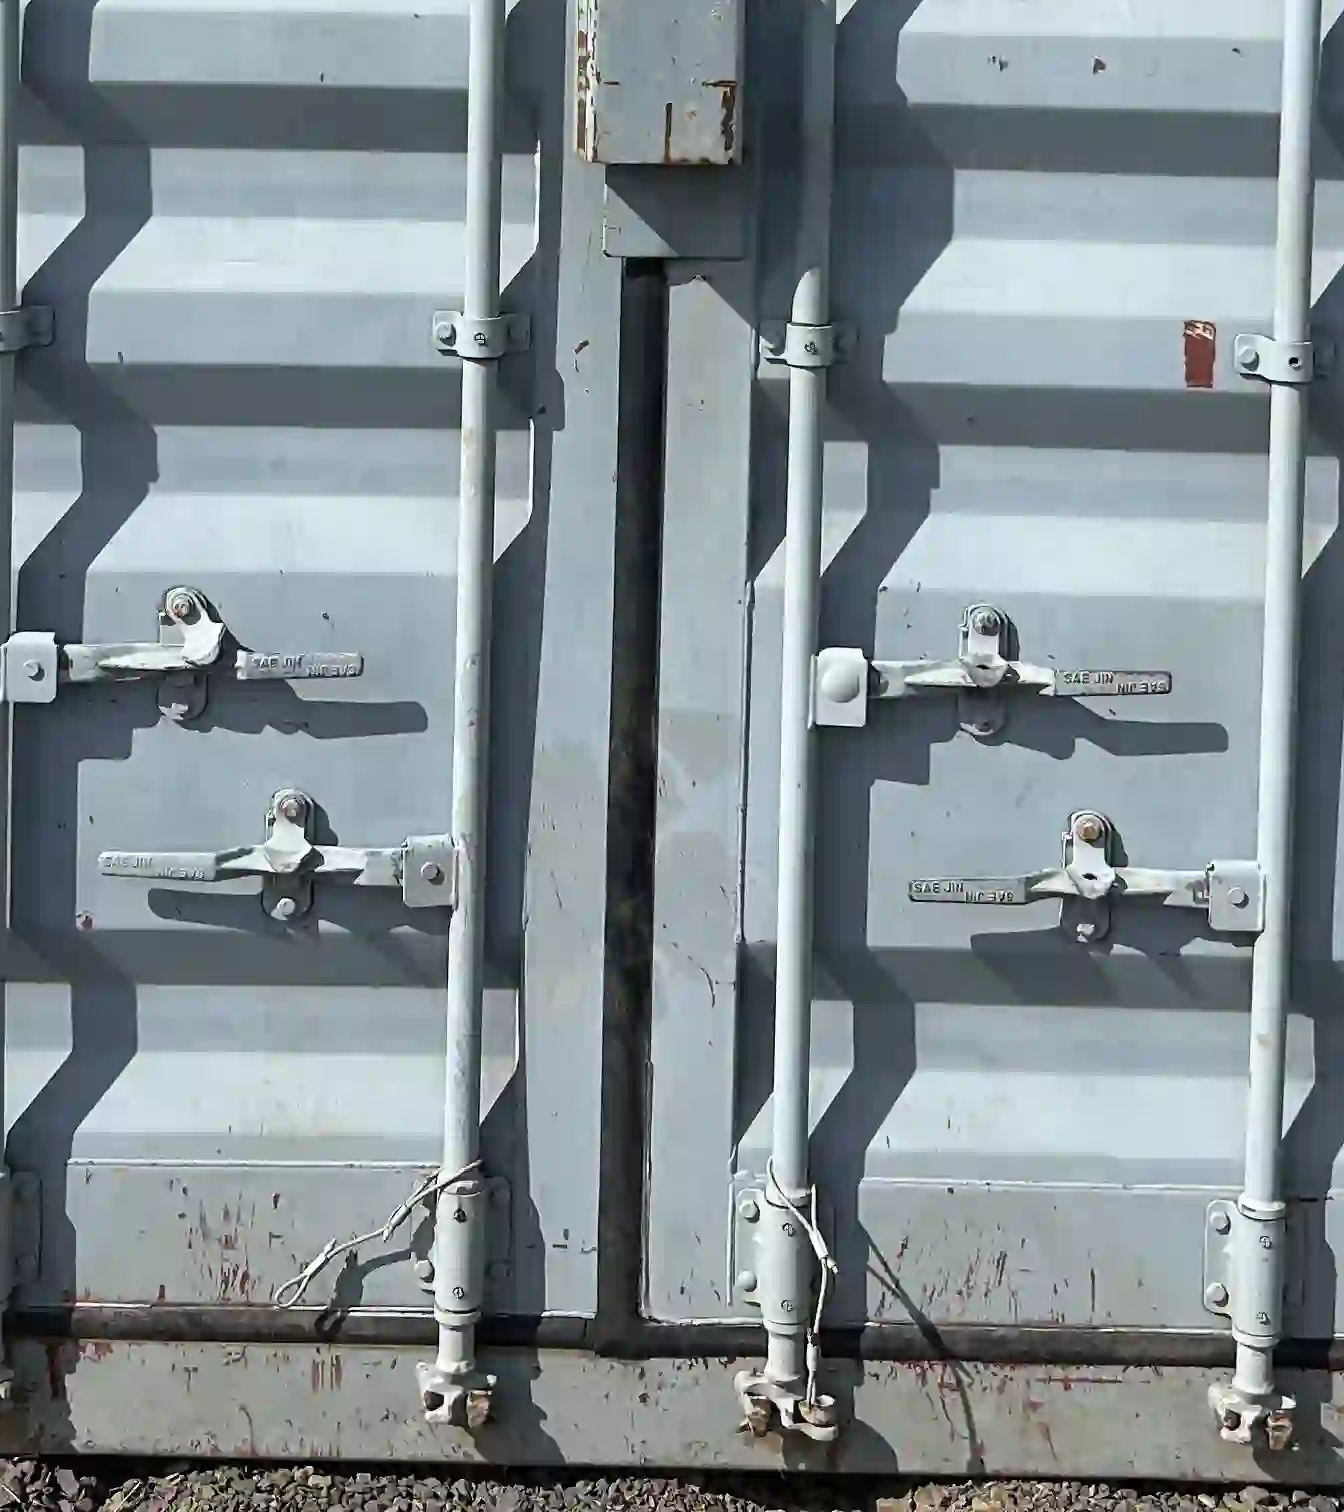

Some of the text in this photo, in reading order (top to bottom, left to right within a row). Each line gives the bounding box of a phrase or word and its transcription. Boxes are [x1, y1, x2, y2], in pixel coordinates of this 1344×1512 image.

[1063, 672, 1114, 685] SAE JIN
[913, 879, 964, 894] SAE JIN
